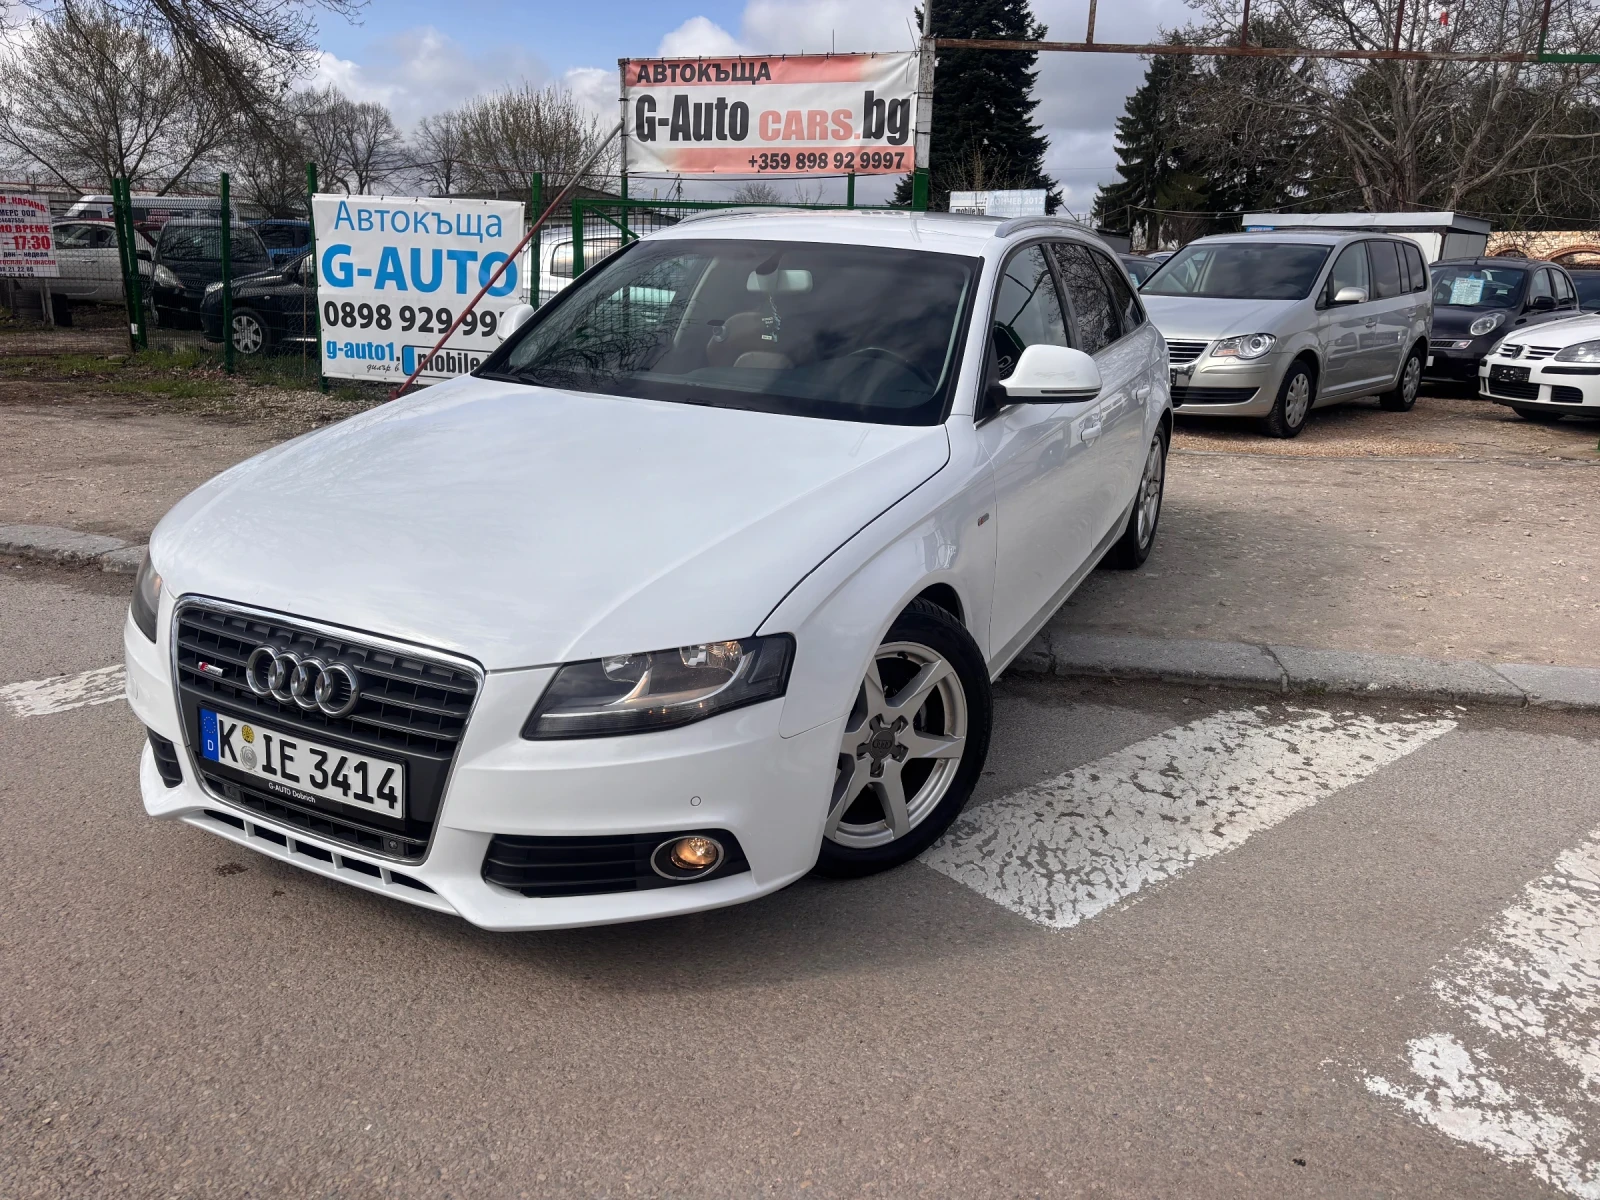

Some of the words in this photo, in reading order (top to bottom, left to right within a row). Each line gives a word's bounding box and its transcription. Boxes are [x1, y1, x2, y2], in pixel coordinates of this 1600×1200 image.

[637, 62, 772, 85] АВТОКЪЩА
[635, 94, 750, 143] G-Auto
[748, 152, 791, 170] +359
[795, 152, 828, 169] 898
[833, 152, 855, 169] 92
[859, 151, 905, 169] 9997
[15, 225, 50, 233] ВРЕМЕ
[334, 200, 502, 243] Автокъща
[12, 236, 50, 250] 17:30
[321, 243, 518, 297] G-AUTO
[323, 300, 392, 330] 0898
[399, 304, 453, 334] 929
[462, 308, 504, 337] 99
[207, 739, 214, 751] D
[219, 719, 238, 763] K
[262, 733, 300, 783] IE
[309, 747, 398, 809] 3414
[268, 782, 291, 796] G-AUTO
[292, 789, 316, 803] Dobrich
